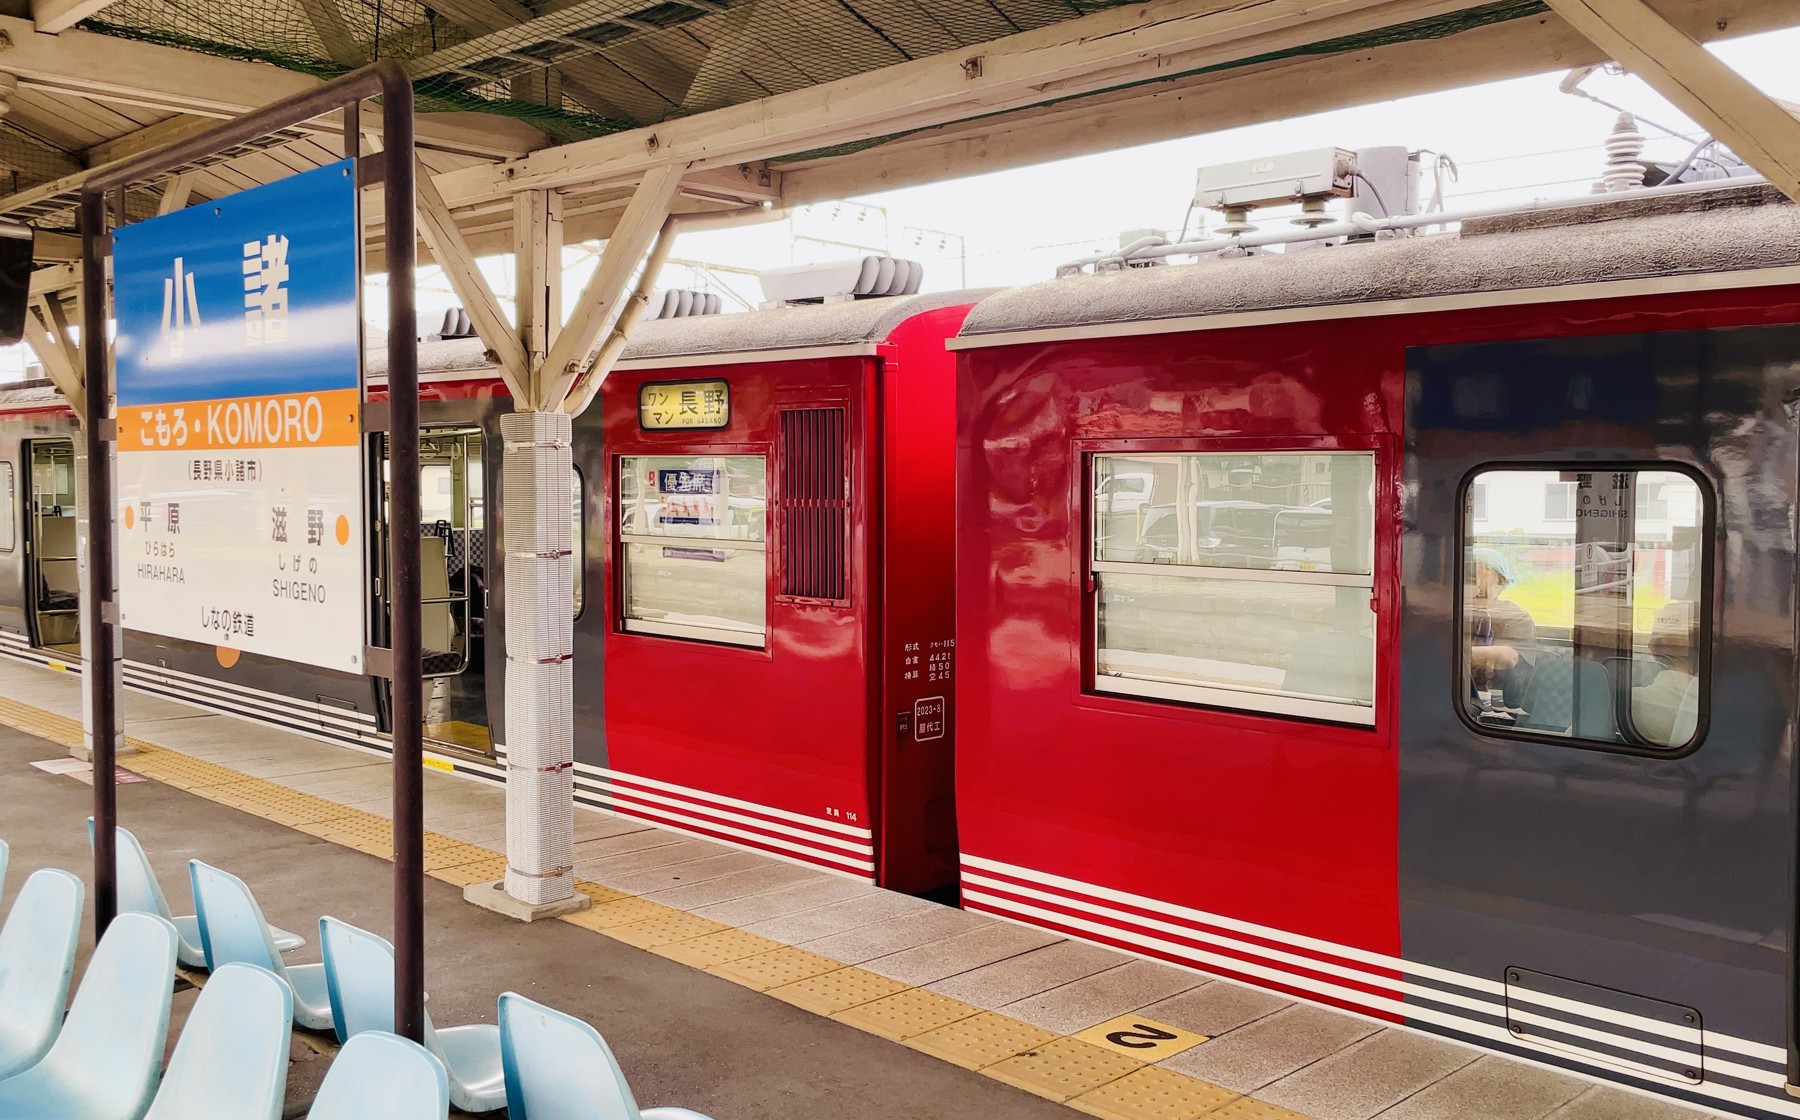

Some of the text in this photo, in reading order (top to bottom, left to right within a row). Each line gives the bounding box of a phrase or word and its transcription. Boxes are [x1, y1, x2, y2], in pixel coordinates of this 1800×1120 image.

[161, 234, 290, 358] 小諸
[679, 389, 725, 416] 長野
[145, 541, 176, 558] ひらはら
[137, 563, 186, 585] HIRAHARA
[278, 553, 318, 574] しげの
[272, 579, 326, 604] SHIGENO
[201, 605, 255, 637] しなの鉄道
[916, 704, 941, 716] 2023-8
[846, 811, 858, 822] 114
[1105, 1023, 1178, 1049] 2
